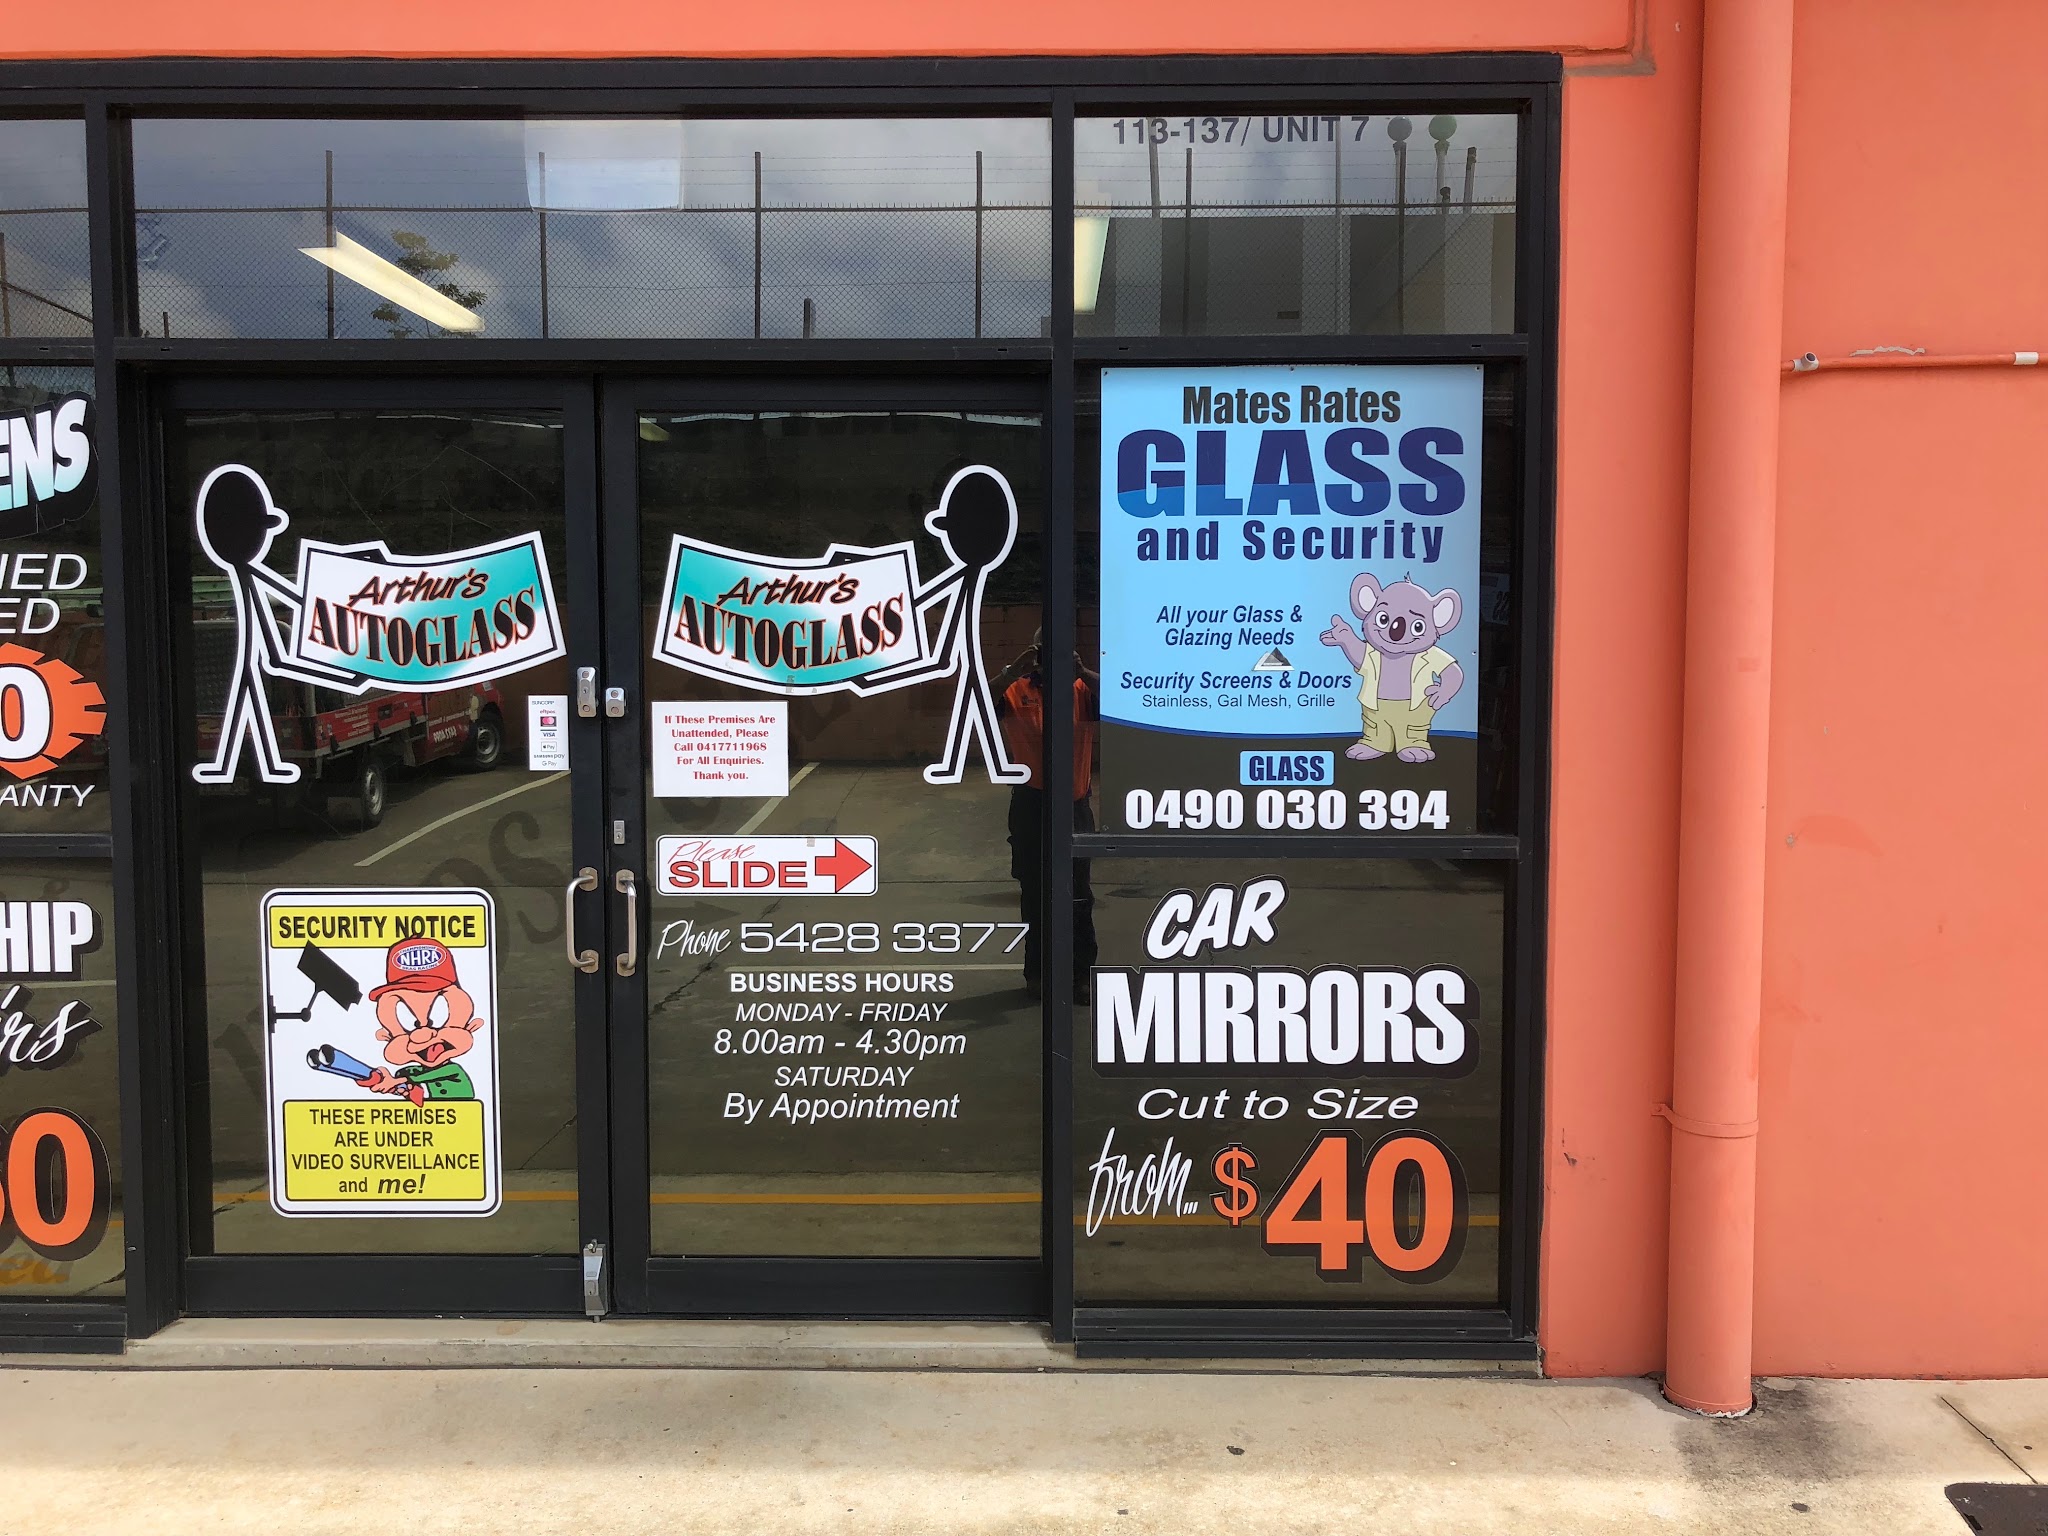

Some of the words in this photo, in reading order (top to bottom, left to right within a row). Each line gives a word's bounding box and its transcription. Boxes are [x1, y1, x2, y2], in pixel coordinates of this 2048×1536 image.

[1113, 117, 1252, 146] 113-137/
[1263, 116, 1341, 142] UNIT
[1352, 116, 1370, 141] 7
[1182, 385, 1290, 424] Mates
[1300, 385, 1400, 423] Rates
[1117, 426, 1465, 518] GLASS
[1137, 521, 1219, 560] and
[1243, 519, 1443, 563] Security
[349, 568, 489, 606] Arthur's
[717, 573, 859, 607] Arthur's
[308, 586, 537, 667] AUTOGLASS
[1156, 605, 1182, 624] All
[1186, 609, 1227, 628] your
[1233, 605, 1284, 623] Glass
[1289, 605, 1303, 623] &
[674, 593, 904, 670] AUTOGLASS
[1165, 628, 1232, 650] Glazing
[1238, 628, 1295, 646] Needs
[1120, 671, 1194, 693] Security
[1199, 671, 1273, 689] Screens
[1279, 671, 1292, 688] &
[1298, 671, 1352, 689] Doors
[1142, 694, 1212, 710] Stainless,
[1217, 694, 1243, 708] Gal
[1247, 694, 1292, 710] Mesh,
[1297, 694, 1335, 708] Grille
[664, 715, 672, 724] If
[674, 715, 705, 724] These
[708, 715, 755, 724] Premises
[758, 715, 776, 724] Are
[671, 729, 733, 739] Unattended,
[735, 729, 769, 738] Please
[674, 742, 693, 751] Call
[697, 742, 767, 751] 0417711968
[677, 756, 694, 765] For
[697, 756, 710, 765] All
[713, 756, 764, 767] Enquiries.
[1248, 755, 1325, 781] GLASS
[693, 771, 724, 780] Thank
[727, 773, 749, 782] you.
[1125, 789, 1244, 830] 0490
[1256, 789, 1347, 830] 030
[1358, 789, 1450, 830] 394
[667, 840, 756, 865] Please
[668, 860, 808, 888] SLIDE
[278, 916, 388, 939] SECURITY
[395, 915, 476, 939] NOTICE
[1146, 879, 1286, 960] CAR
[657, 919, 732, 960] Phone
[740, 922, 880, 953] 5428
[892, 922, 1030, 953] 3377
[400, 950, 439, 966] NHRA
[730, 973, 857, 992] BUSINESS
[865, 973, 955, 992] HOURS
[735, 1003, 842, 1022] MONDAY
[859, 1003, 948, 1022] FRIDAY
[1096, 970, 1466, 1065] MIRRORS
[714, 1028, 824, 1055] 8.00am
[855, 1028, 967, 1060] 4.30pm
[774, 1066, 914, 1087] SATURDAY
[724, 1093, 764, 1125] By
[769, 1093, 960, 1125] Appointment
[1137, 1088, 1230, 1120] Cut
[1244, 1089, 1290, 1120] to
[1307, 1088, 1419, 1120] Size
[309, 1108, 365, 1125] THESE
[370, 1108, 457, 1125] PREMISES
[334, 1131, 369, 1147] ARE
[374, 1131, 434, 1147] UNDER
[291, 1154, 344, 1170] VIDEO
[349, 1154, 480, 1170] SURVEILLANCE
[338, 1178, 368, 1193] and
[377, 1174, 426, 1194] me!
